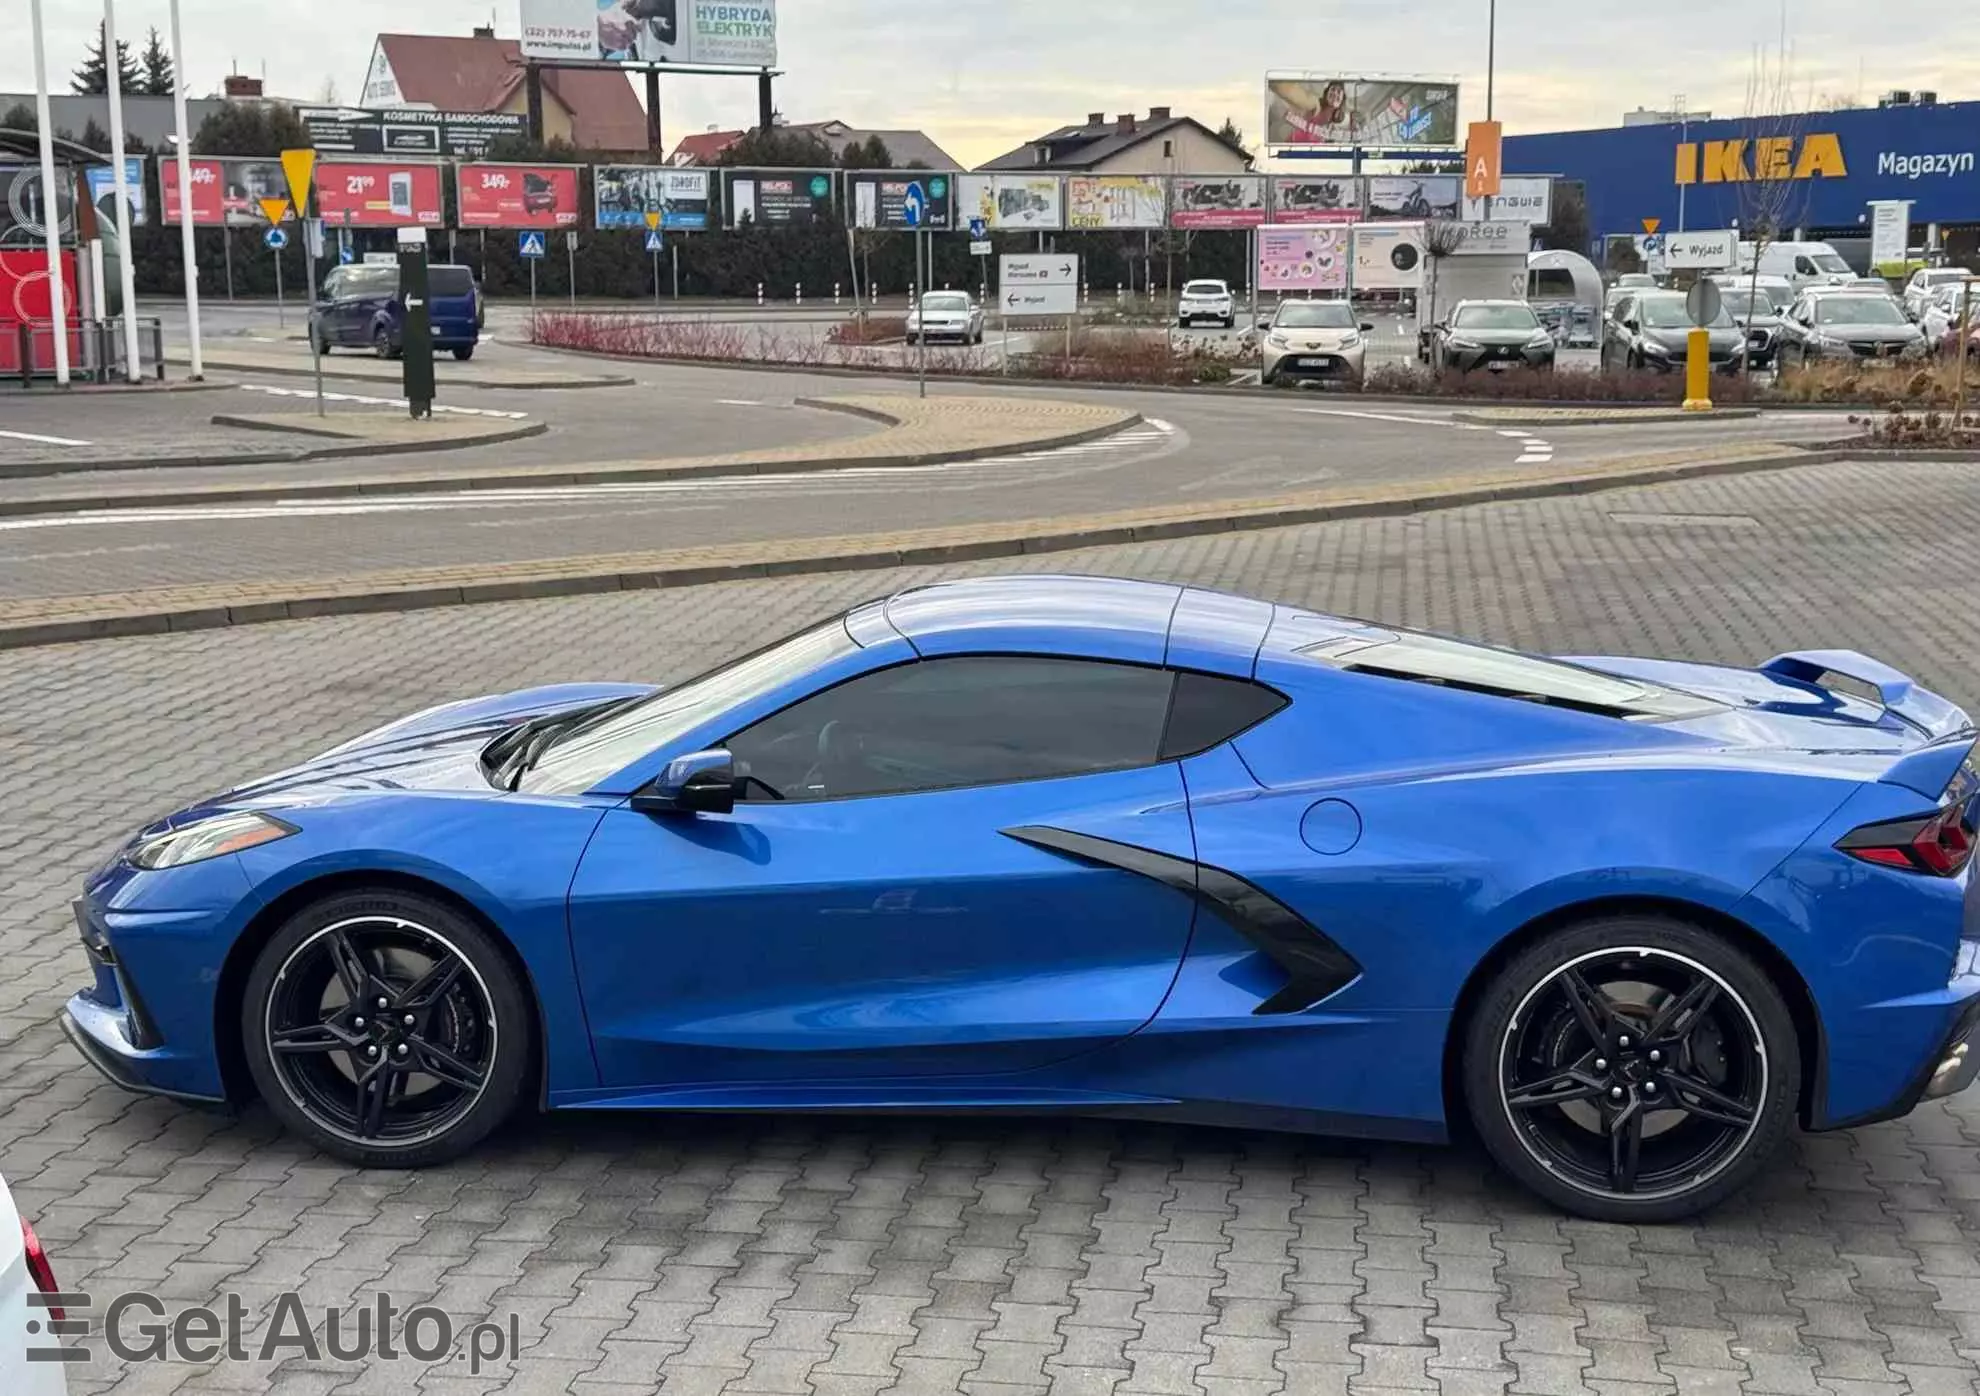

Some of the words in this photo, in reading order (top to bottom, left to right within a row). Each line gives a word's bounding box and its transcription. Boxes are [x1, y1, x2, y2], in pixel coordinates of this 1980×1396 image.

[696, 6, 773, 22] HYBRYDA
[383, 112, 442, 122] KOSMETYKA
[1474, 157, 1488, 178] A
[1675, 132, 1847, 185] IKEA
[1877, 152, 1974, 179] Magazyn
[1689, 243, 1724, 257] Wyjazd
